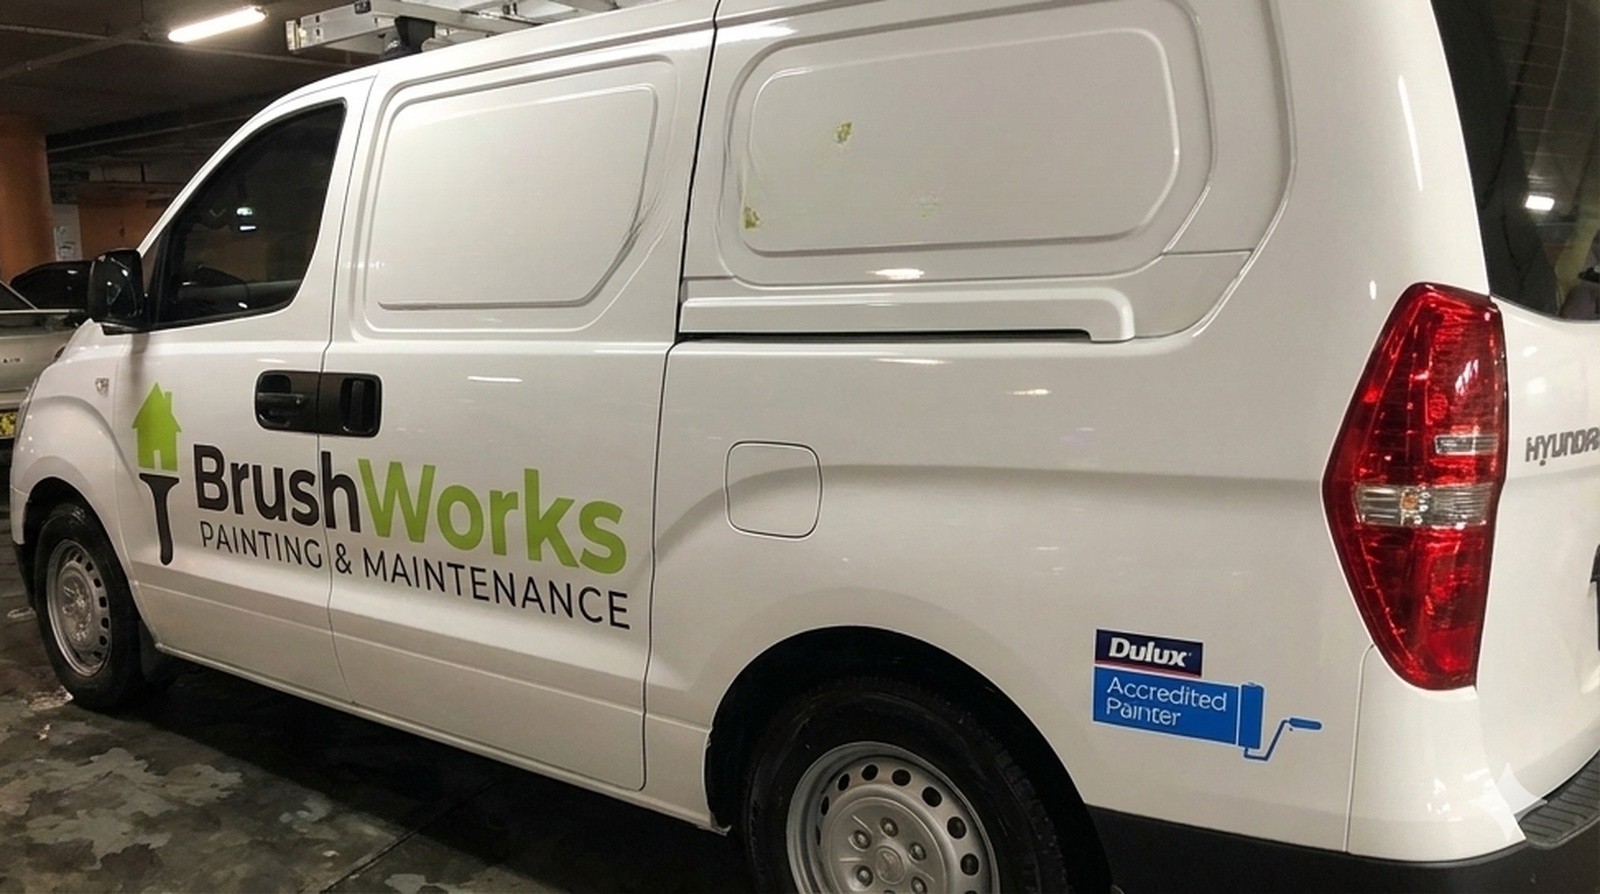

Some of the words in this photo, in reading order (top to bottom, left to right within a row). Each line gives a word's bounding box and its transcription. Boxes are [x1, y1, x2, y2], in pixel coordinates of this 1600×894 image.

[1525, 427, 1600, 462] HYUNDA
[193, 443, 627, 575] BrushWorks
[199, 520, 323, 569] PAINTING
[335, 542, 353, 575] &
[362, 547, 631, 630] MAINTENANCE
[1109, 637, 1187, 667] Dulux
[1106, 676, 1227, 712] Accredited
[1106, 697, 1181, 726] Painter
